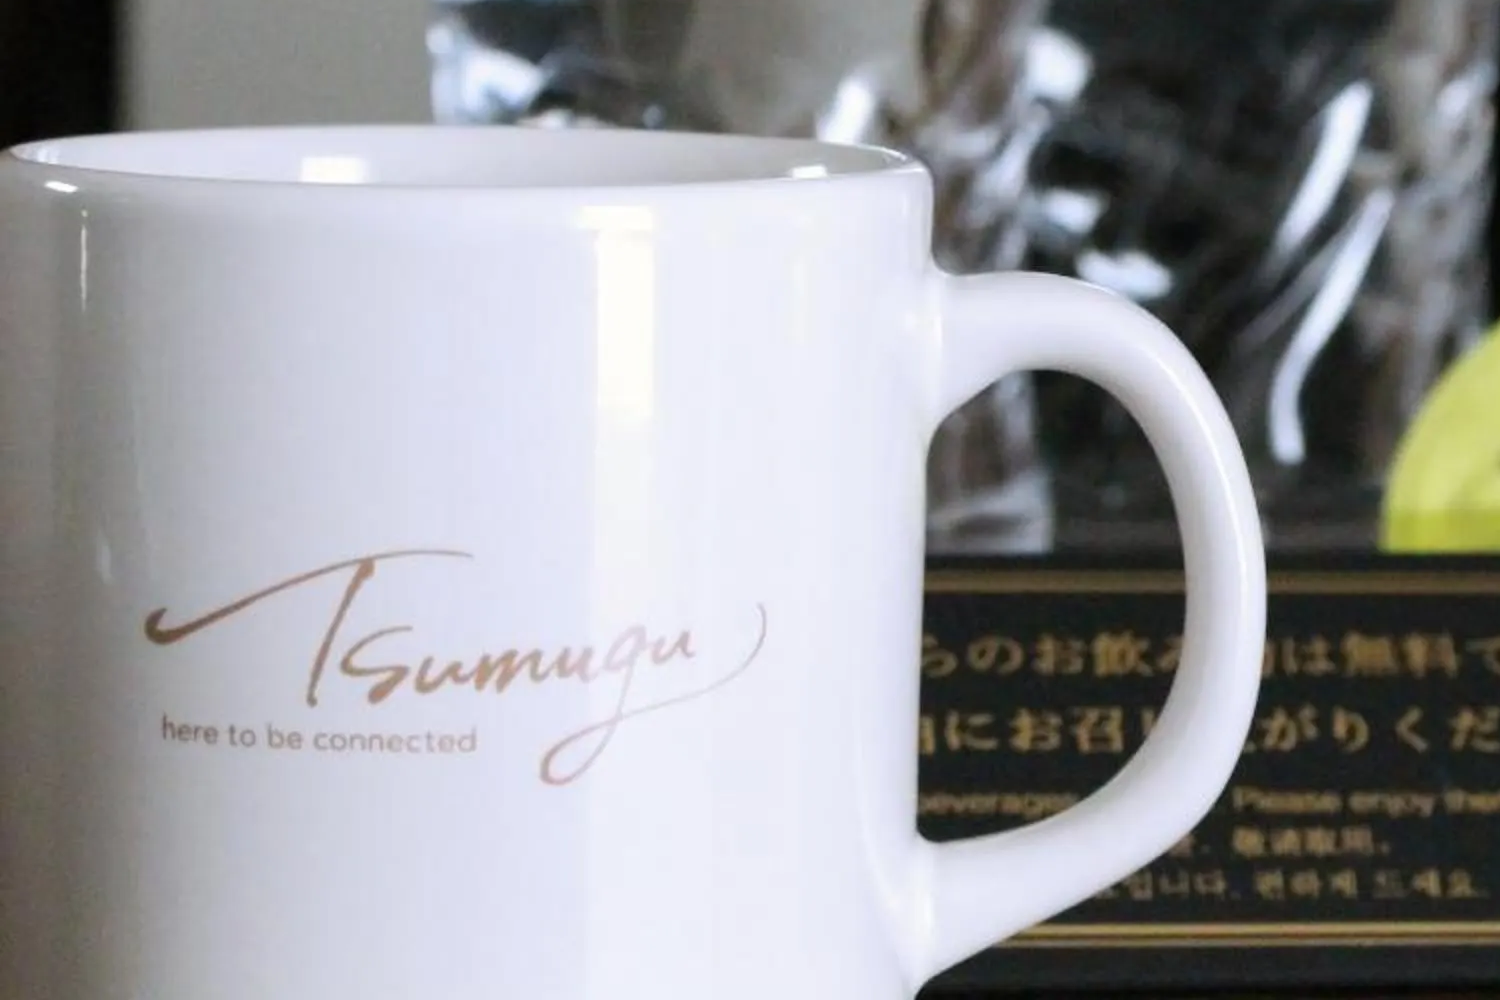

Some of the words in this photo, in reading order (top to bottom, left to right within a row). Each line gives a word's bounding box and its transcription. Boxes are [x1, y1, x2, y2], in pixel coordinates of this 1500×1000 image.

[143, 550, 767, 786] Tsumugu
[161, 712, 219, 745] here
[229, 722, 257, 748] to
[266, 722, 304, 751] be
[312, 725, 478, 754] connected
[1233, 787, 1341, 813] Please
